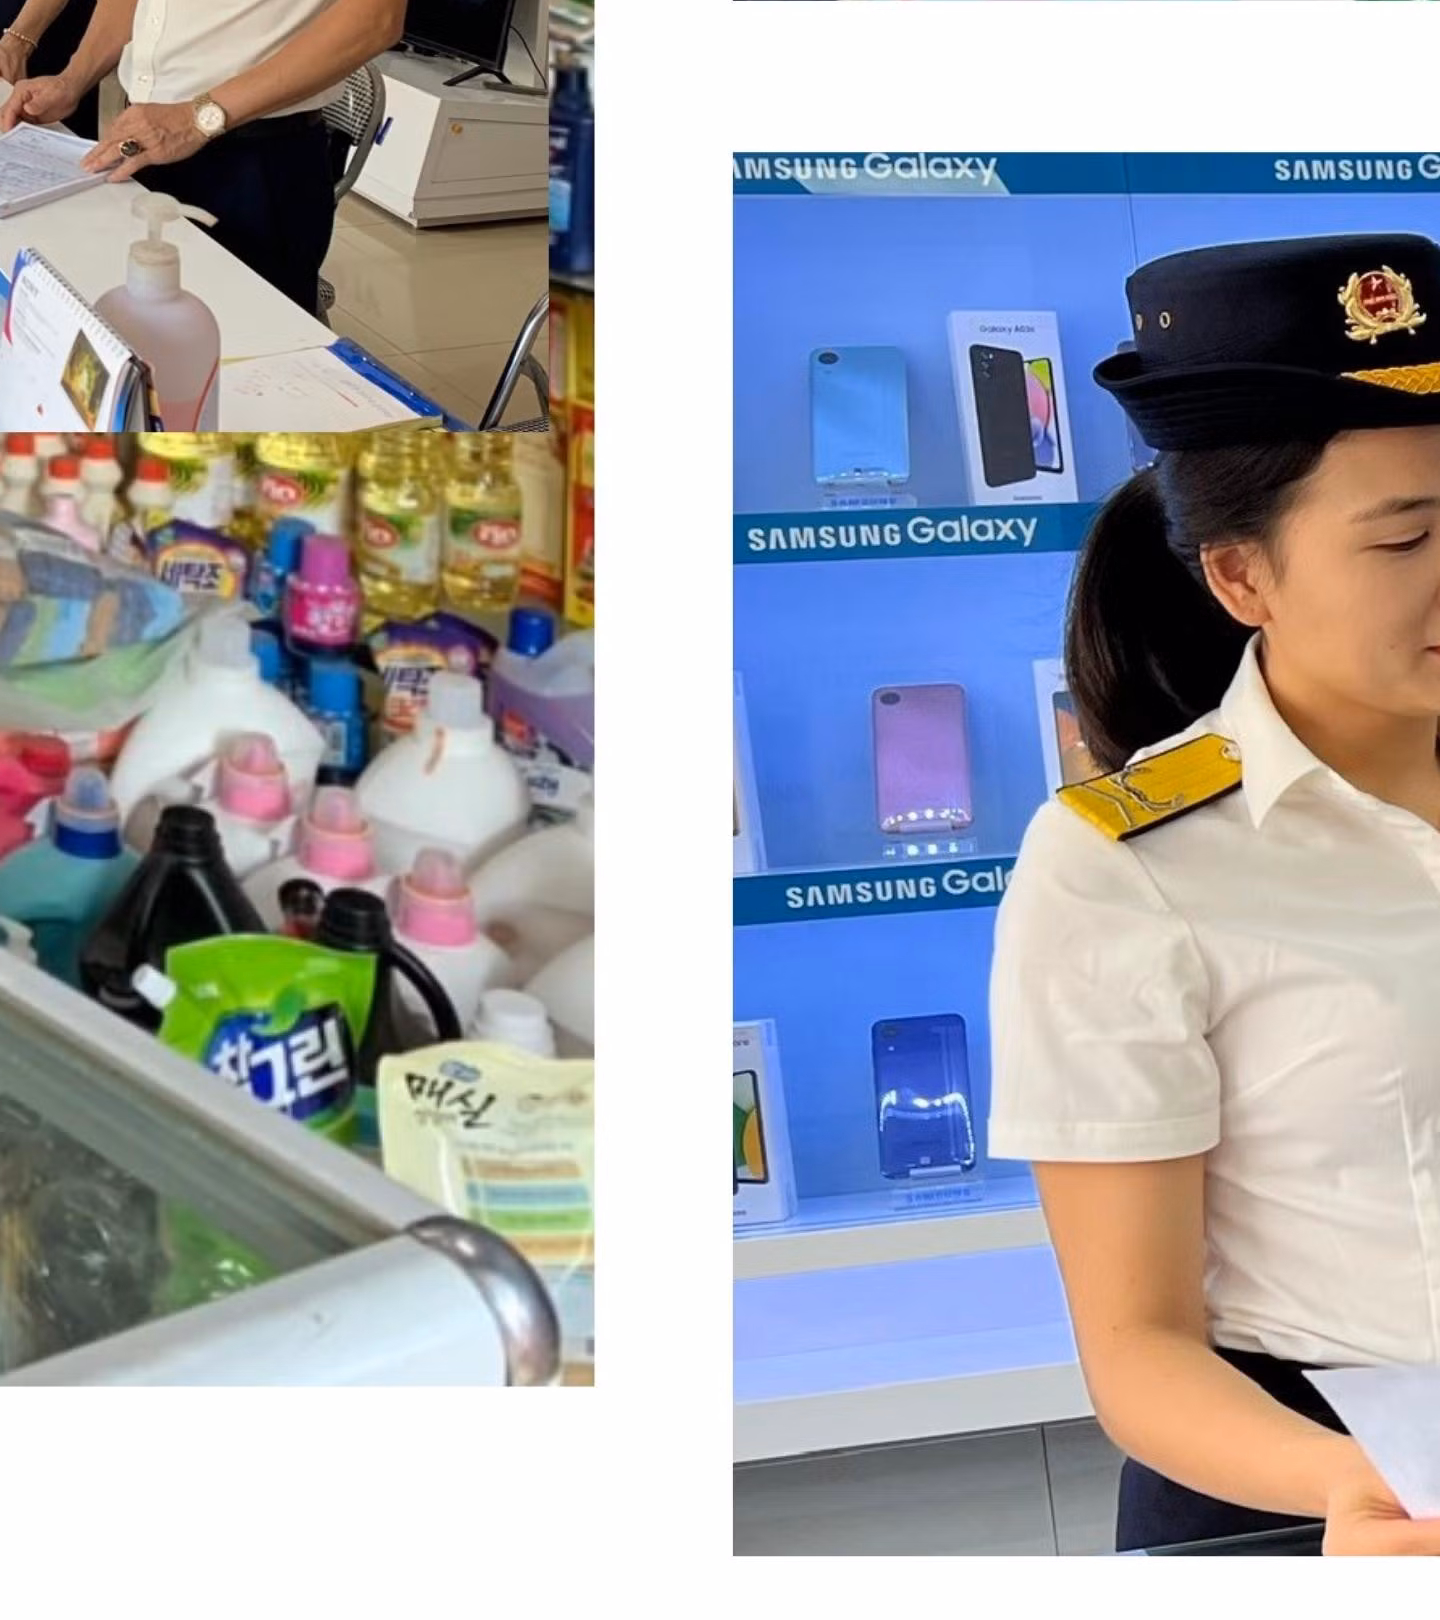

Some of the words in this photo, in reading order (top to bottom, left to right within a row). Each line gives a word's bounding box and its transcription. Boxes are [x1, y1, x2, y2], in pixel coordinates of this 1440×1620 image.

[863, 152, 998, 185] Galaxy
[1274, 159, 1412, 181] SAMSUNG
[748, 524, 901, 551] SAMSUNG
[907, 516, 1038, 546] Galaxy
[786, 878, 937, 908] SAMSUNG
[941, 866, 1016, 894] Gal
